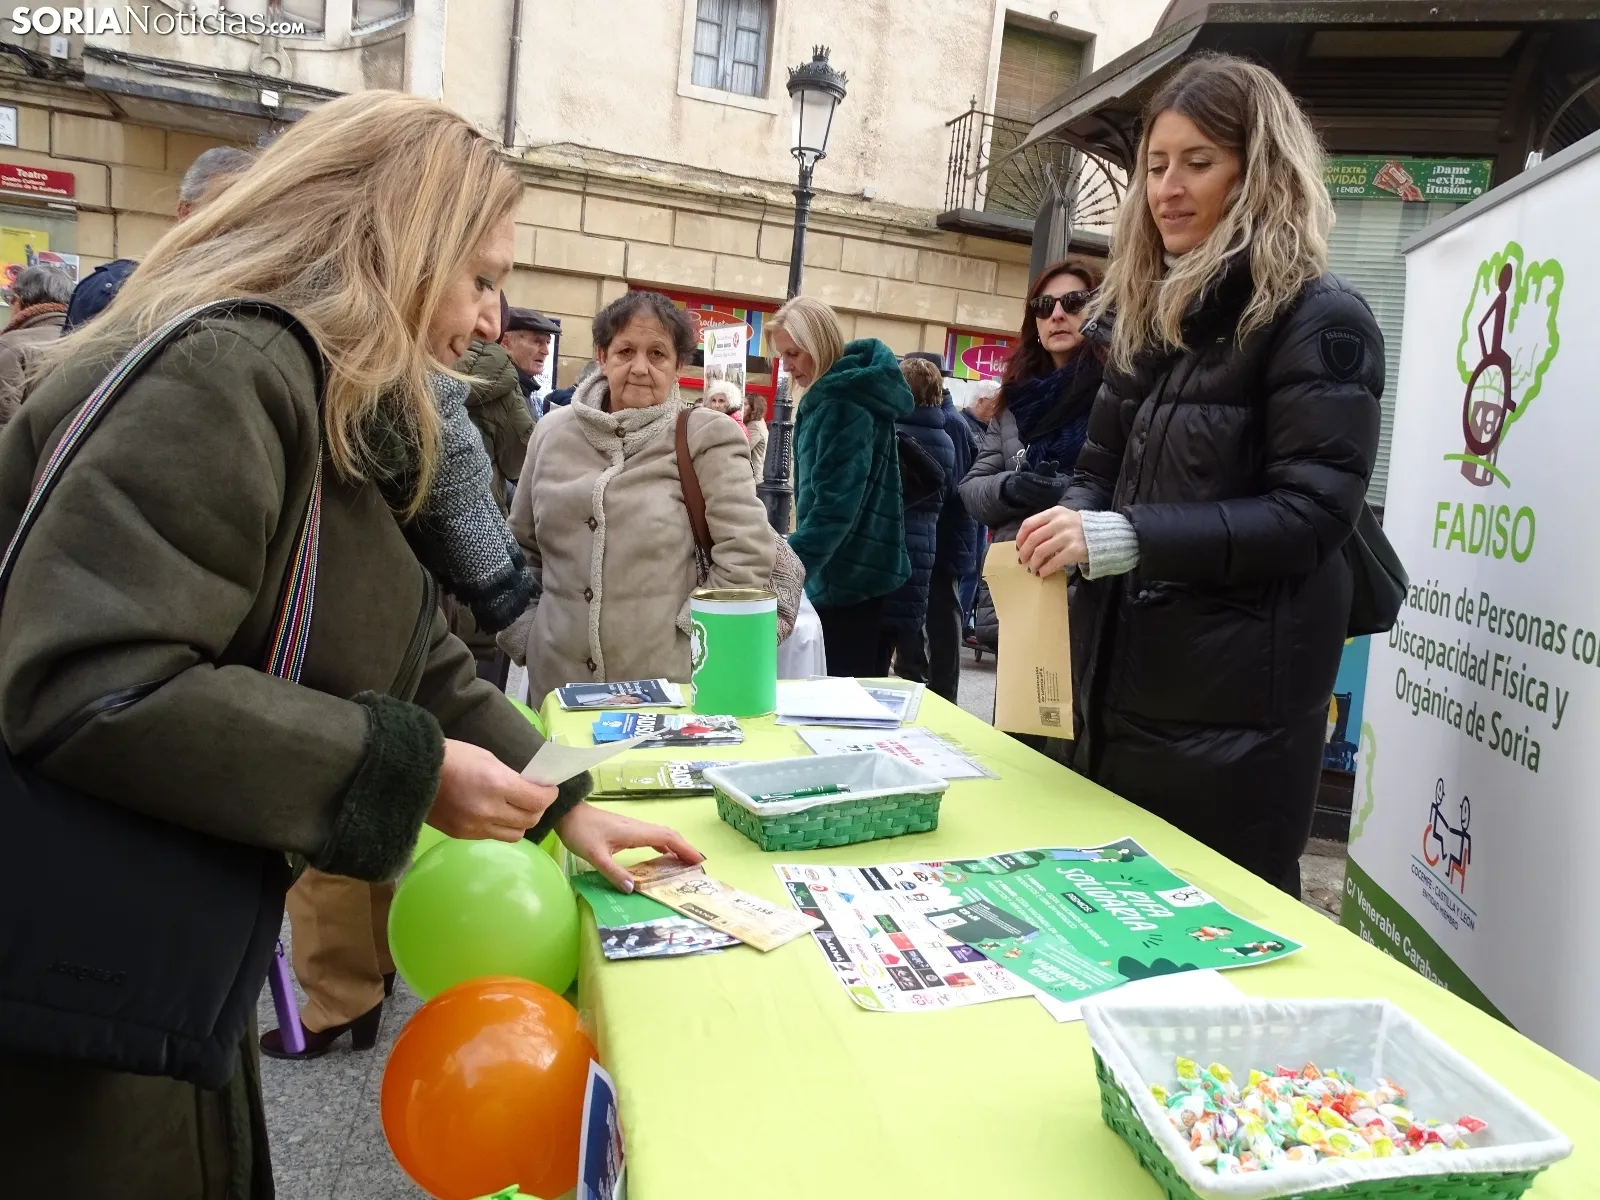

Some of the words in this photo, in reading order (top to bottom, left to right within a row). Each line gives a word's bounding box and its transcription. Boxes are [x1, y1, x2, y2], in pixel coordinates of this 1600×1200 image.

[16, 168, 48, 180] Teatro
[1324, 174, 1367, 185] AVIDAD
[1340, 186, 1365, 194] ENERO
[1432, 501, 1536, 563] FADISO
[1455, 587, 1474, 625] de
[1476, 591, 1567, 655] Personas
[1388, 619, 1489, 687] Discapacidad
[1491, 652, 1550, 713] Física
[1551, 686, 1570, 731] y
[1396, 667, 1463, 731] Orgánica
[1466, 708, 1485, 743] de
[1489, 711, 1541, 773] Soria
[1056, 867, 1159, 931] SOLIDARIA
[1116, 889, 1175, 917] RIFA
[1346, 877, 1356, 898] C/
[1357, 887, 1401, 946] Venerable
[1434, 886, 1456, 913] CASTILLA
